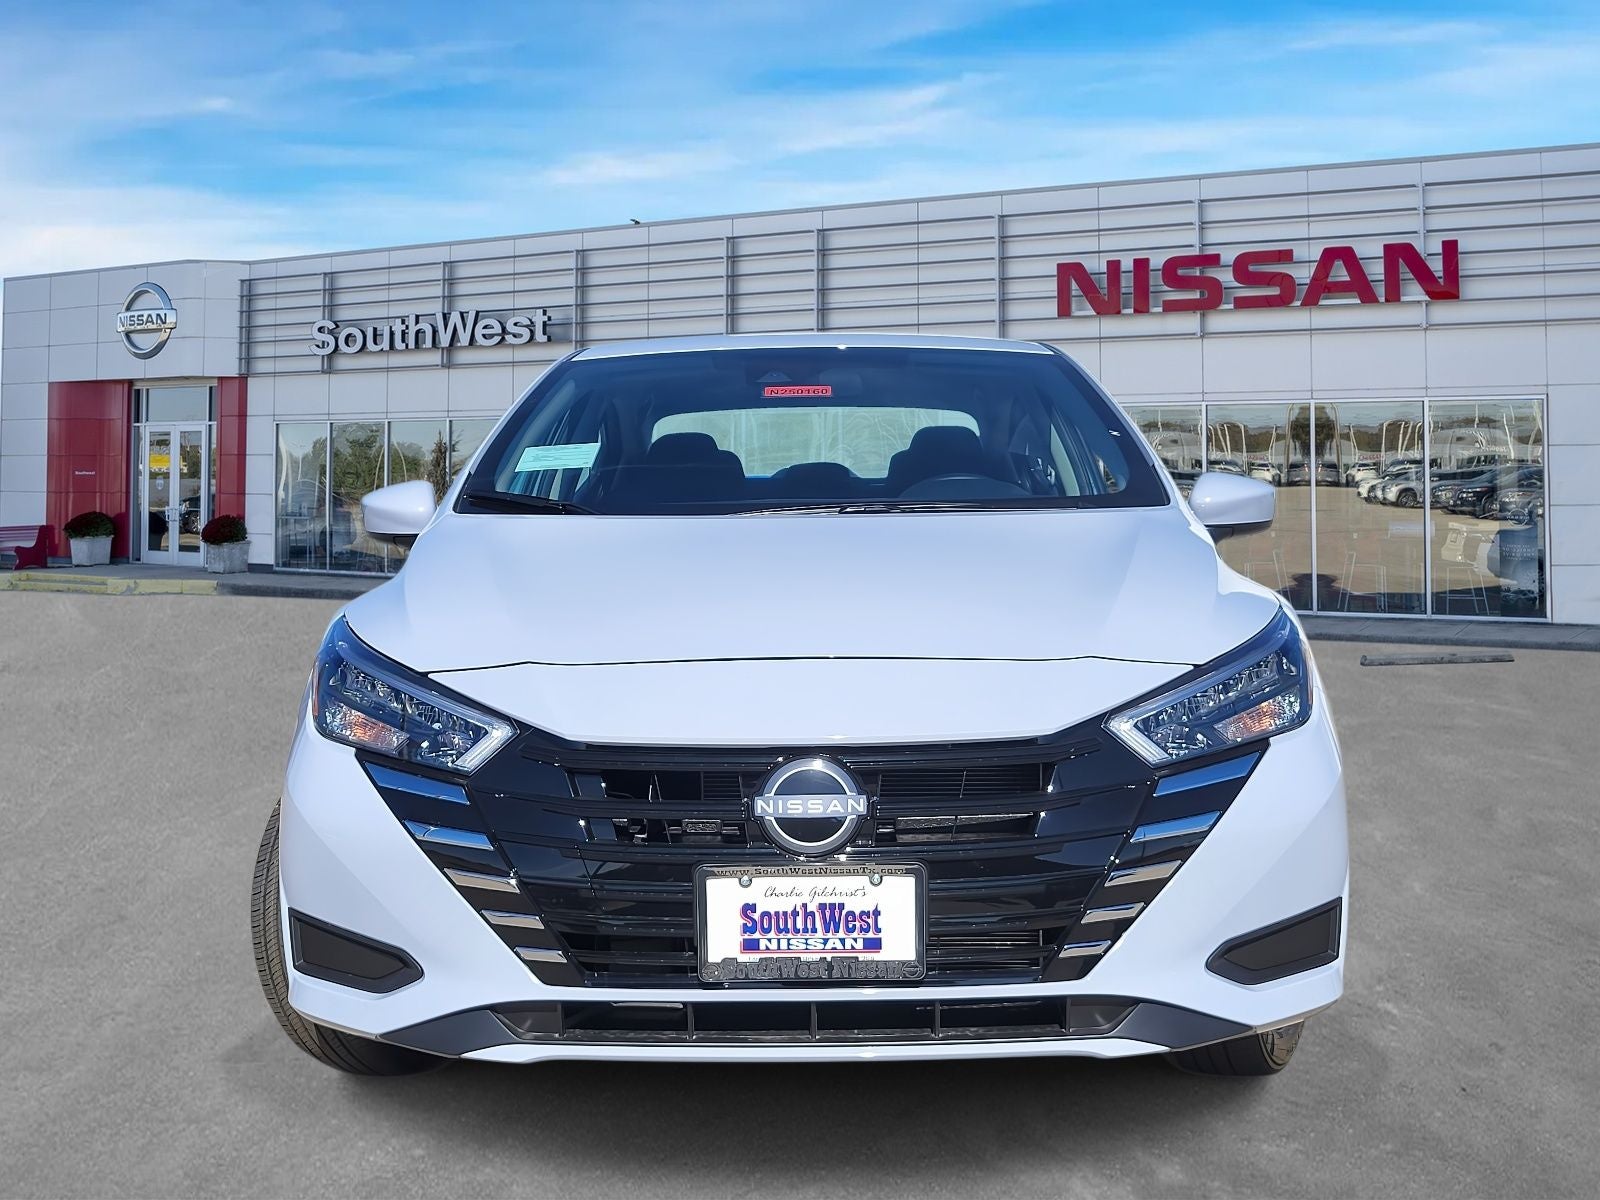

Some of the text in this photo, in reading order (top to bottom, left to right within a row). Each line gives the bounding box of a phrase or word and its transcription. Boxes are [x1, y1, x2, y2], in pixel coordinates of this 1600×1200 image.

[1056, 239, 1460, 317] NISSAN
[119, 313, 167, 327] NISSAN
[309, 308, 551, 356] SouthWest
[757, 798, 864, 813] NISSAN
[764, 885, 868, 904] Charlie Gilchrist's
[740, 902, 882, 936] SouthWest
[759, 938, 864, 950] NISSAN
[720, 957, 902, 979] SouthWest Nissan
